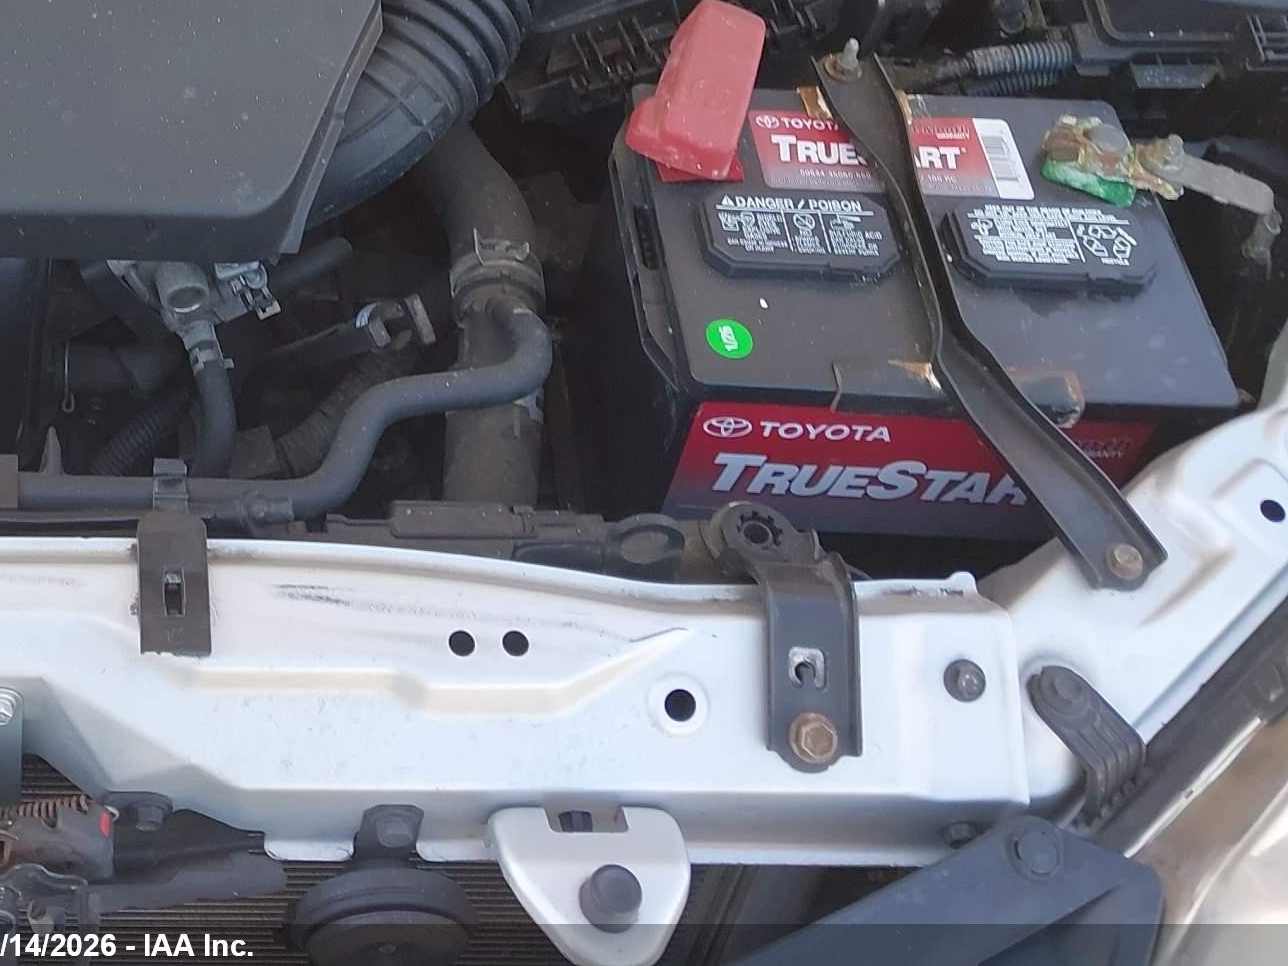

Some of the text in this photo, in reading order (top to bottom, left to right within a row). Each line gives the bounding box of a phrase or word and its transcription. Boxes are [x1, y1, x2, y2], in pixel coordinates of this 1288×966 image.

[735, 196, 793, 210] DANGER
[808, 199, 862, 212] POISON
[760, 420, 891, 443] TOYOTA
